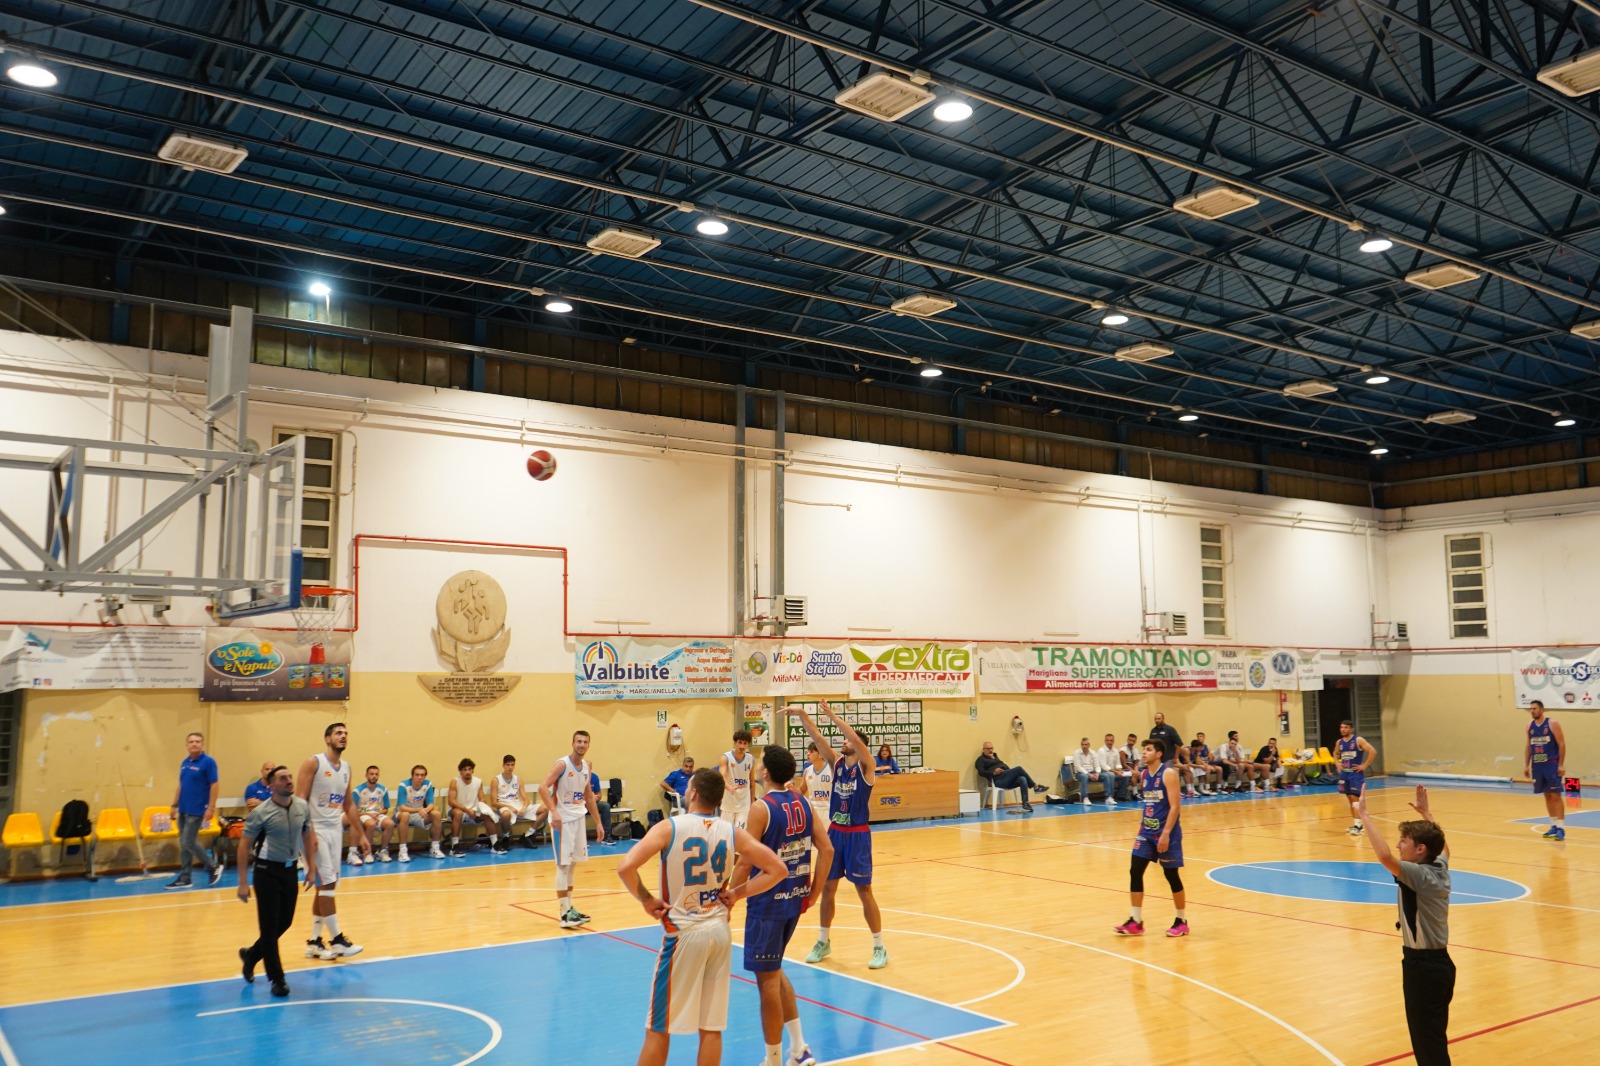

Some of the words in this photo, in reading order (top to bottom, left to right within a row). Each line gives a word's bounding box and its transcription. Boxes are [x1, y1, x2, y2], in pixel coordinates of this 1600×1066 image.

[225, 646, 256, 661] Sole
[773, 652, 802, 663] Vis-Dà
[811, 651, 842, 663] Santo
[893, 643, 970, 671] extra
[1032, 647, 1211, 667] TRAMONTANO
[231, 660, 277, 676] Napule
[583, 663, 670, 680] Valbibite
[806, 662, 847, 677] Stefano
[1029, 669, 1068, 677] Marigliano
[1071, 667, 1174, 679] SUPERMERCATI
[859, 672, 964, 686] SUPERMERCATI
[1045, 680, 1099, 688] Alimentaristi
[875, 725, 920, 734] MARIGLIANO
[821, 774, 830, 782] 00
[1565, 779, 1579, 790] 24
[737, 821, 745, 829] 14
[781, 801, 806, 836] 10
[683, 837, 727, 886] 24
